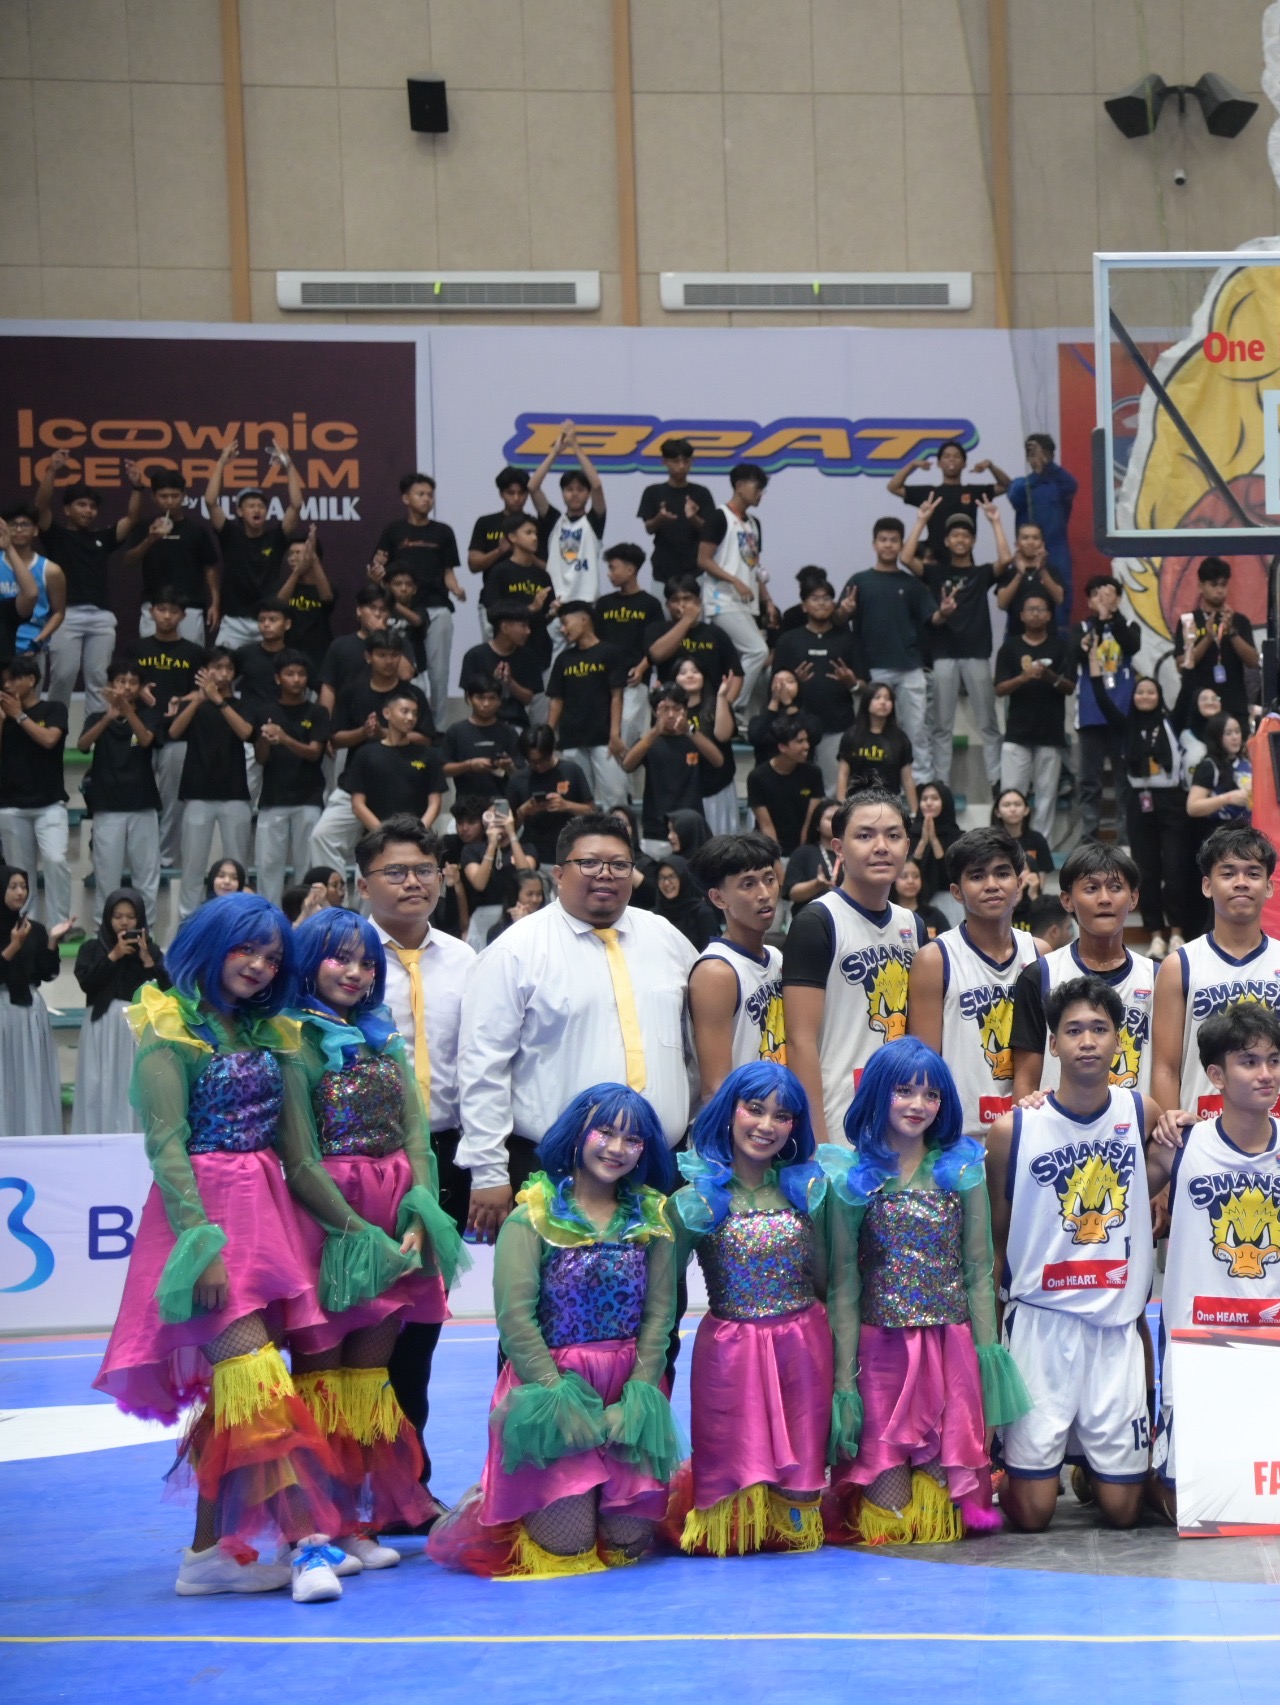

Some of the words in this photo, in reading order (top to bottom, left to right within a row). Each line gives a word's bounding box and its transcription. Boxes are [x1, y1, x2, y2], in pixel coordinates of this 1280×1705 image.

[1203, 331, 1265, 363] One
[19, 457, 122, 487] ICE
[300, 497, 361, 521] MILK
[839, 944, 917, 985] SMANS
[1201, 1108, 1219, 1119] One
[1029, 1139, 1136, 1187] SMANSA
[1047, 1278, 1065, 1288] One
[1197, 1311, 1214, 1322] One
[1131, 1416, 1149, 1451] 15
